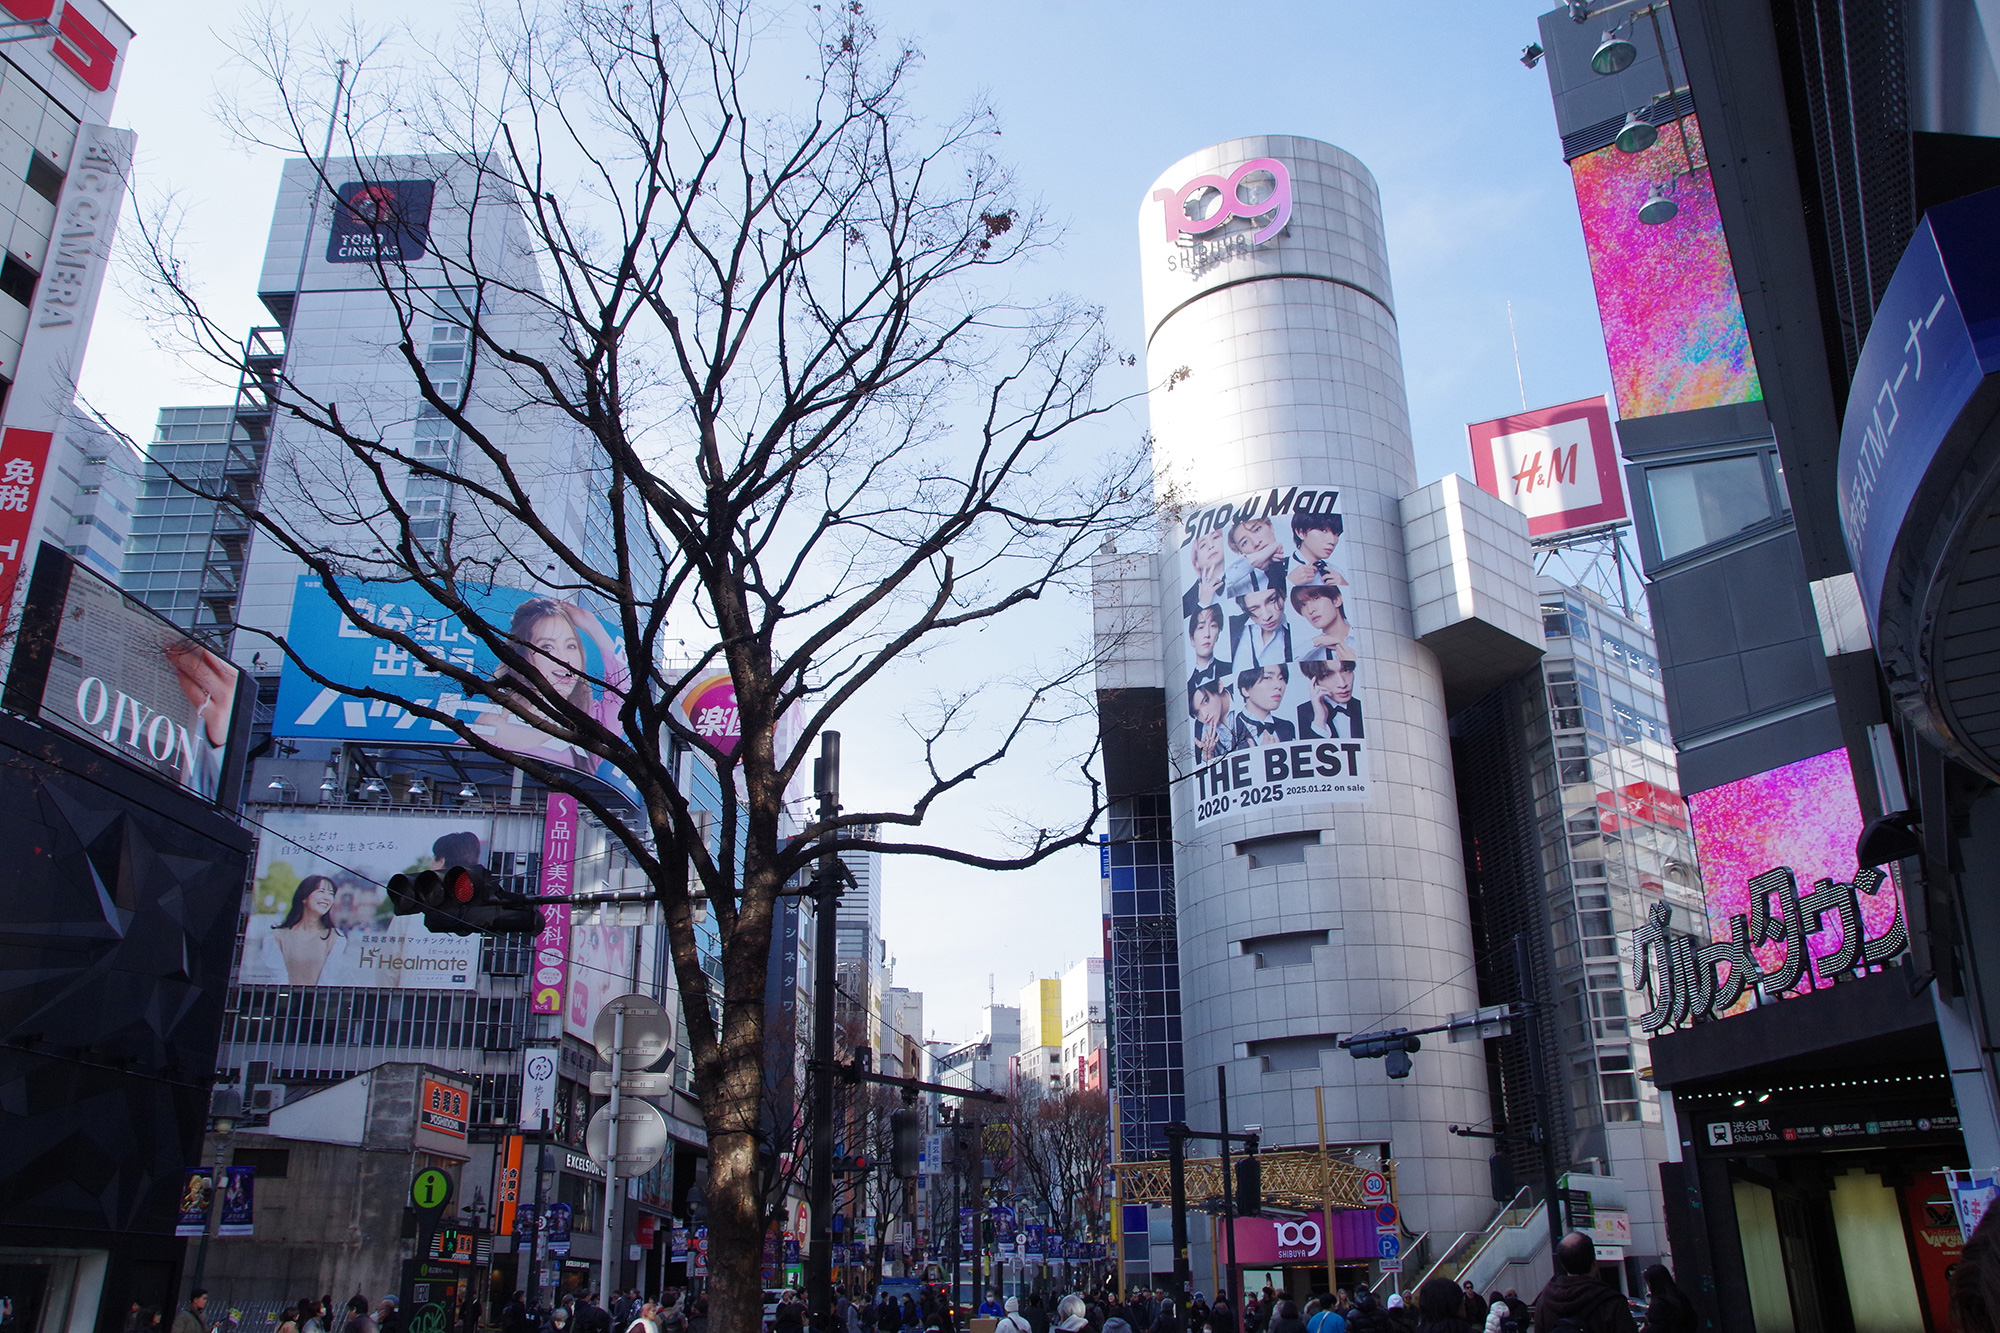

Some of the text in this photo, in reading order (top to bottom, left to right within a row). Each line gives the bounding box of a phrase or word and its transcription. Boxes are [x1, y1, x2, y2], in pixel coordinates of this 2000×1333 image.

[1153, 157, 1293, 246] 109
[39, 196, 100, 329] CAMERA
[338, 246, 399, 257] CINEMAS
[0, 457, 35, 513] 免税
[1512, 443, 1578, 496] H&M
[1179, 486, 1340, 549] Snow Man
[76, 676, 203, 777] OJYON
[1195, 743, 1362, 801] THE BEST
[1286, 784, 1333, 795] 2025.01.22
[1346, 783, 1366, 792] sale
[1197, 796, 1230, 822] 2020
[1240, 784, 1284, 808] 2025
[541, 820, 571, 946] 品川美容外科
[378, 953, 468, 971] Healmate
[1632, 865, 1908, 1034] グルメタウン
[432, 1086, 461, 1117] 吉野家
[1732, 1119, 1771, 1133] 渋谷駅
[1733, 1132, 1779, 1143] Shibuya Sta.
[566, 1153, 600, 1176] EXCELSIOR
[506, 1168, 519, 1202] 吉野家
[1368, 1178, 1381, 1190] 30
[1273, 1220, 1322, 1257] 109
[1278, 1249, 1306, 1258] SHIBUYA
[1920, 1230, 1964, 1248] VANGUA
